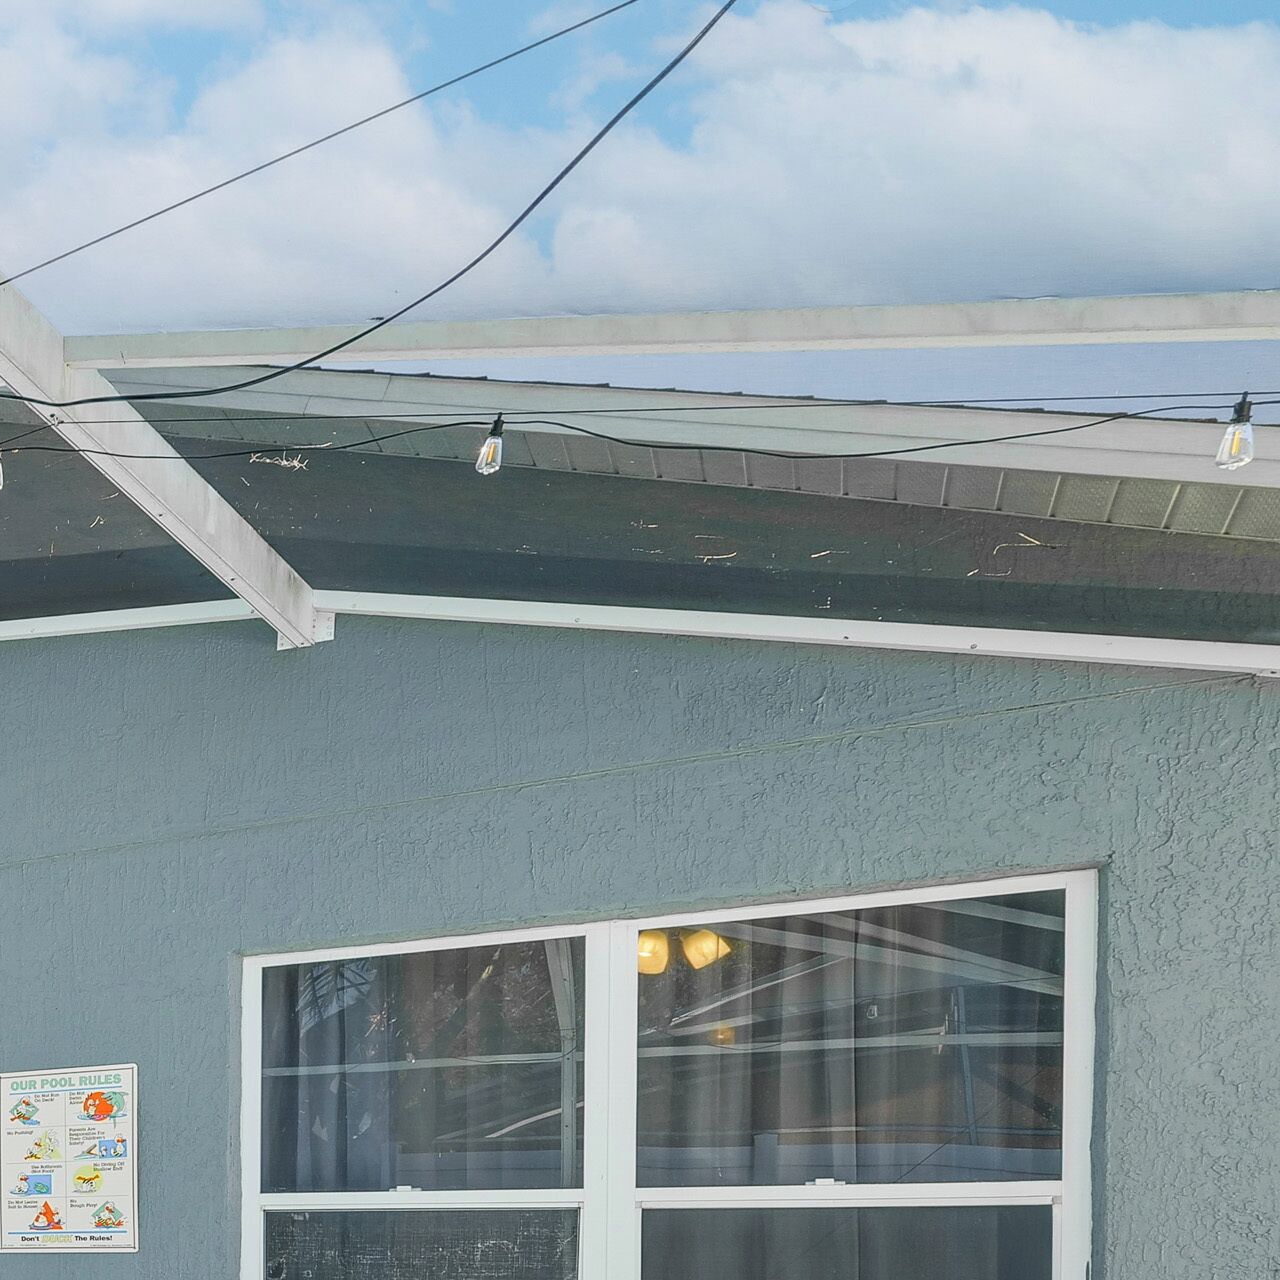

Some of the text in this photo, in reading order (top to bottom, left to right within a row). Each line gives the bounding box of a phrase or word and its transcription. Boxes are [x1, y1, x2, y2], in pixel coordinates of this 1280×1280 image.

[11, 1073, 122, 1090] OUR POOL RULES
